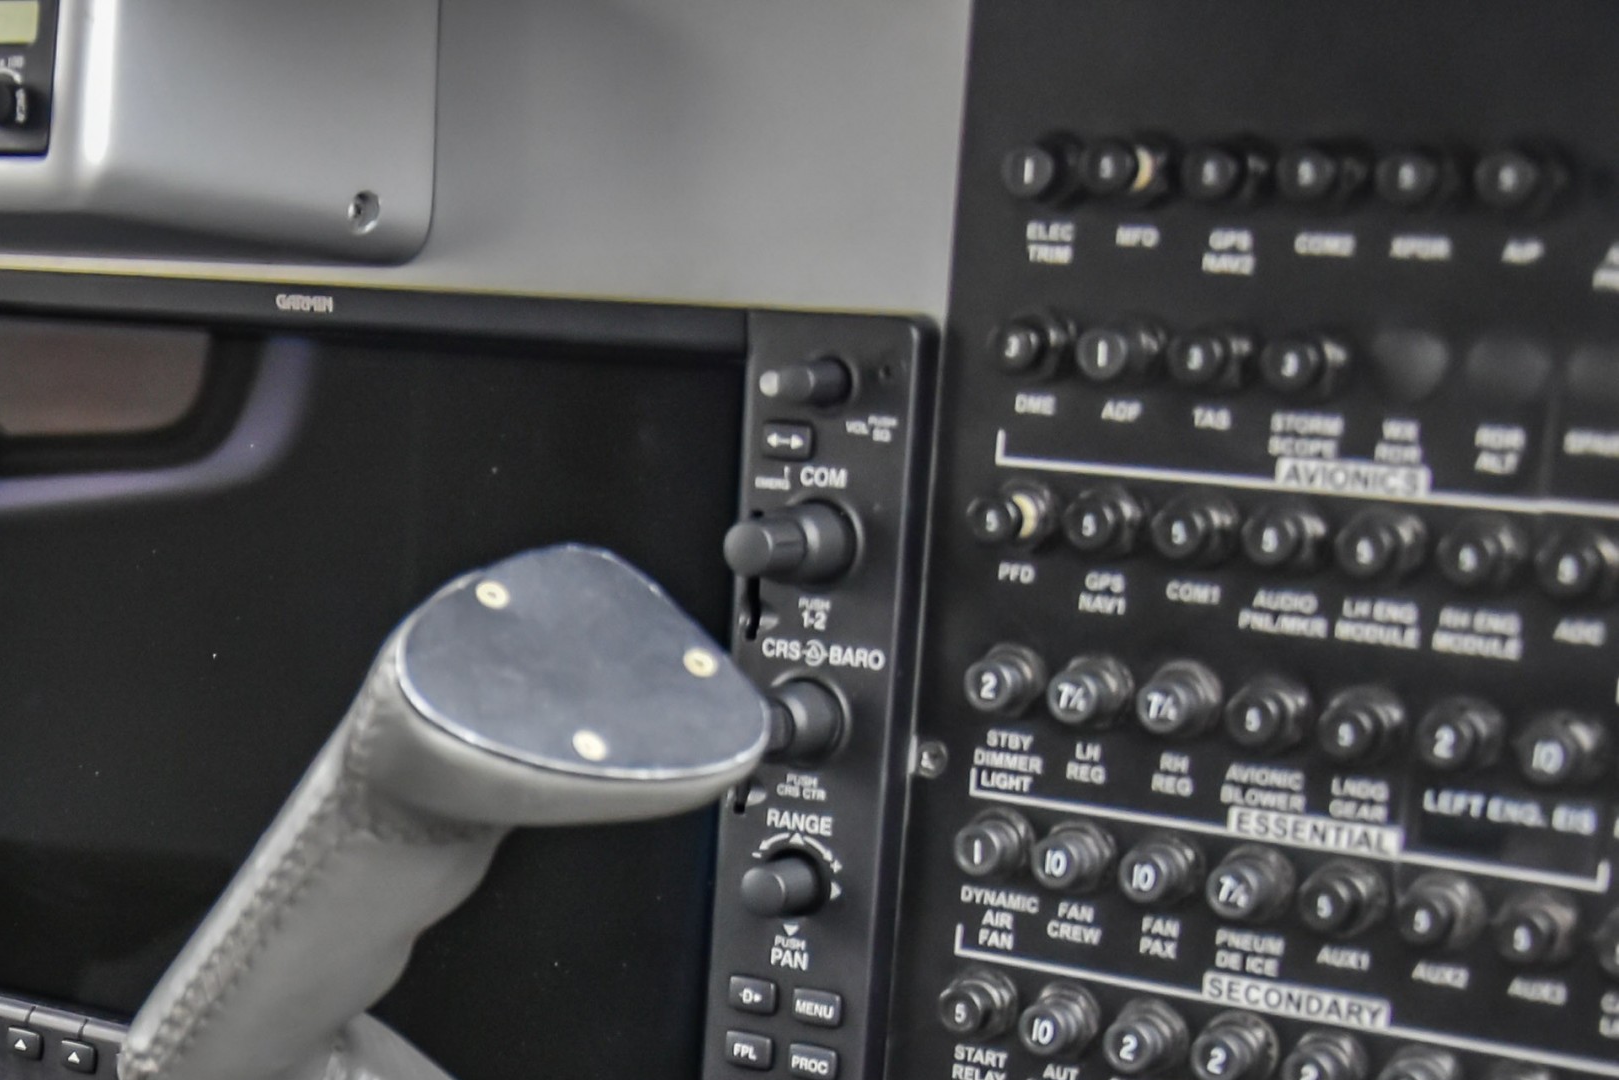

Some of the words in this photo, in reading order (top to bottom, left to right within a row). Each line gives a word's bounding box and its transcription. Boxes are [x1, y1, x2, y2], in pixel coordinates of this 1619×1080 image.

[800, 466, 847, 488] COM
[1285, 460, 1419, 494] AVIONICS
[998, 562, 1036, 584] PFD
[802, 611, 826, 630] 1-2
[762, 638, 801, 661] CRS
[830, 645, 885, 671] BARO
[980, 671, 998, 700] 2
[986, 728, 1034, 751] STBY
[973, 747, 1044, 775] DIMMER
[1075, 742, 1102, 763] LH
[981, 769, 1034, 793] LIGHT
[767, 808, 832, 836] RANGE
[1235, 812, 1390, 849] ESSENTIAL
[1044, 856, 1068, 878] 10
[1132, 863, 1157, 892] 10
[960, 884, 1040, 914] DYNAMIC
[982, 909, 1014, 929] AIR
[1057, 902, 1095, 923] FAN
[774, 935, 805, 951] PUSH
[978, 927, 1014, 950] FAN
[1047, 920, 1102, 945] CREW
[771, 948, 809, 971] PAN
[795, 1000, 834, 1019] MENU
[1207, 977, 1381, 1027] SECONDARY
[1032, 1018, 1054, 1044] 10
[733, 1043, 757, 1061] FPL
[954, 1045, 1007, 1070] START
[1119, 1034, 1138, 1060] 2
[791, 1056, 828, 1075] PROC
[1207, 1047, 1226, 1074] 2
